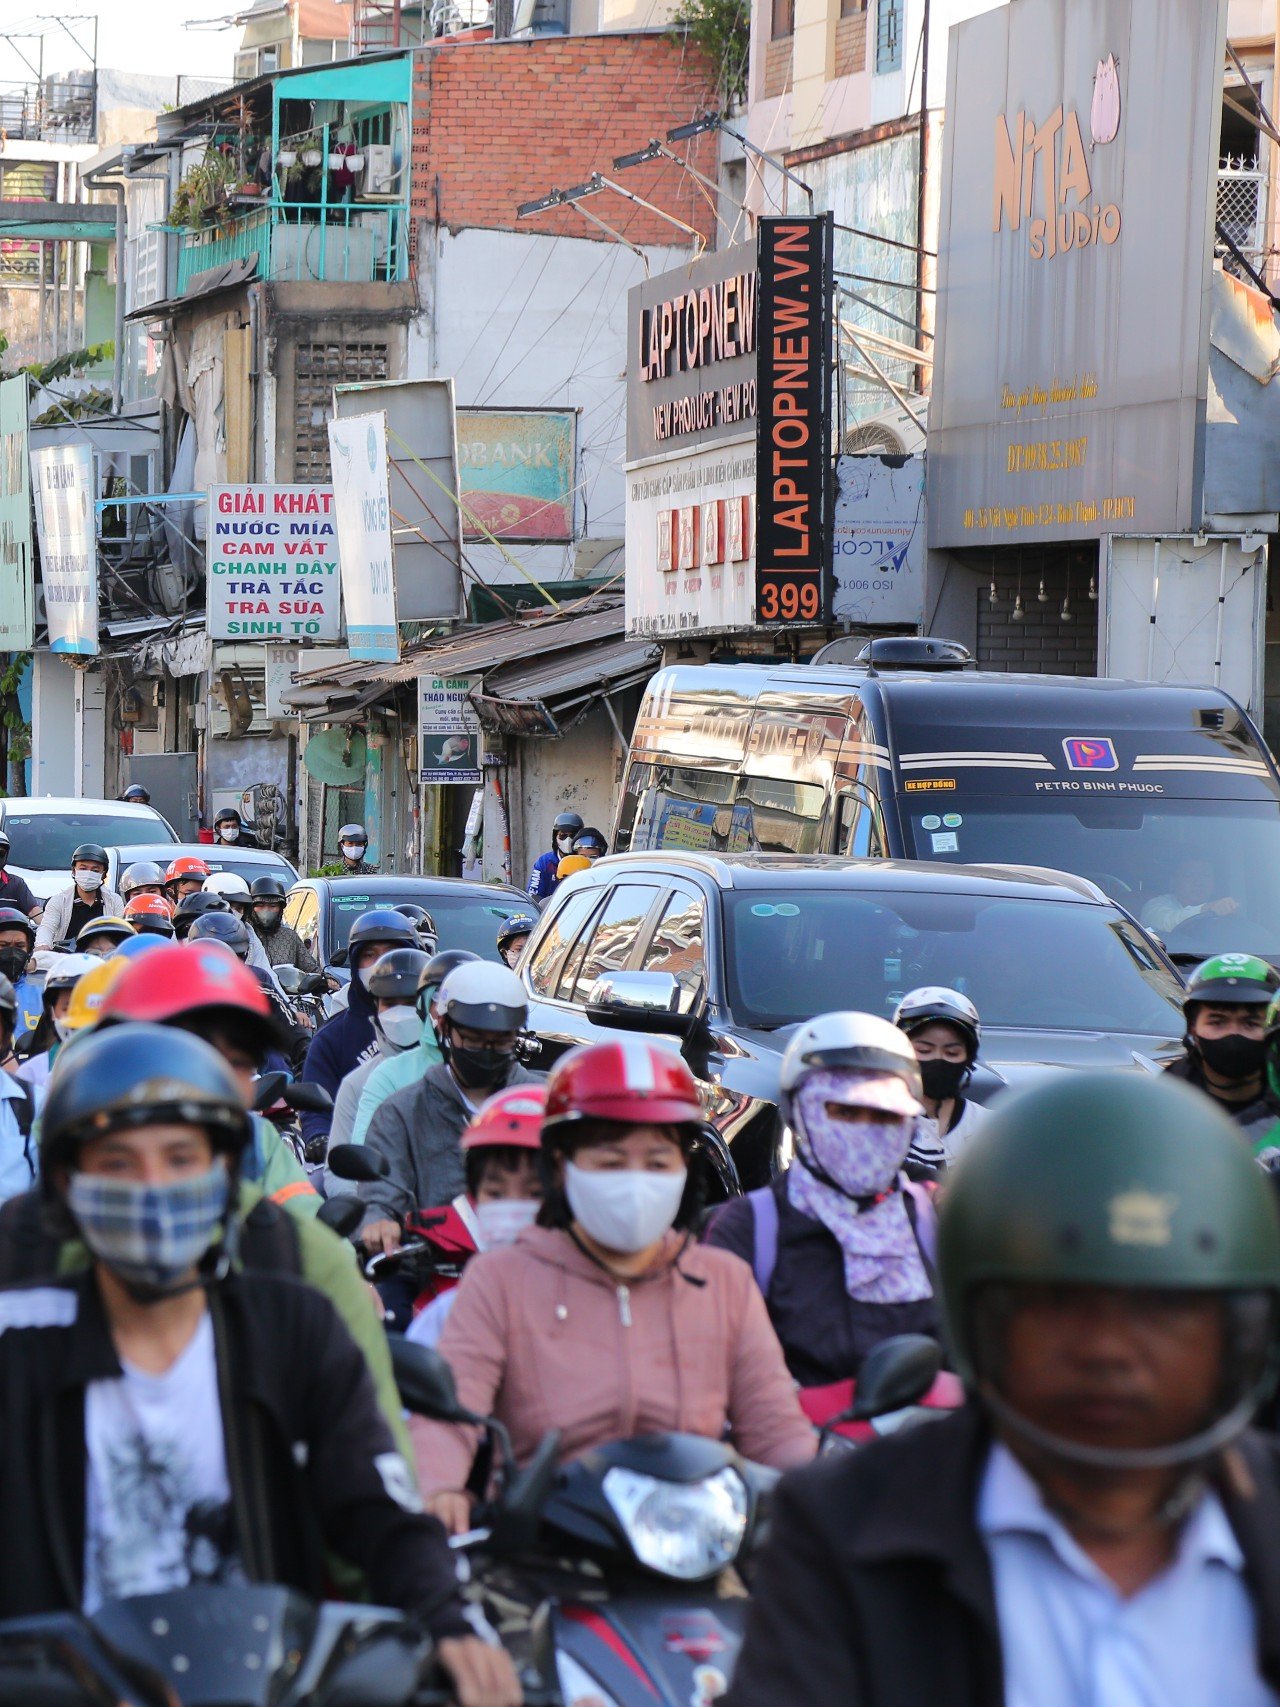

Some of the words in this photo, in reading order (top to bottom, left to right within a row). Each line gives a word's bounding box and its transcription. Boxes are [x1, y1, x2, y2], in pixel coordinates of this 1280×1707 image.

[639, 271, 757, 383] LAPTOPNEW
[773, 225, 809, 557] LAPTOPNEW.VN
[654, 405, 673, 441] NEW
[673, 391, 715, 437] PRODUCT
[720, 384, 742, 424] NEW
[218, 487, 270, 514] GIẢI
[274, 488, 334, 514] KHÁT
[216, 520, 280, 536] NƯỚC
[290, 520, 334, 536] MÍA
[222, 542, 278, 556] CAM
[284, 539, 328, 556] VẮT
[213, 562, 288, 576] CHANH
[296, 559, 337, 576] DÂY
[227, 580, 274, 595] TRÀ
[281, 578, 324, 595] TẮC
[872, 580, 893, 590] ISO
[225, 600, 273, 615] TRÀ
[279, 599, 325, 615] SỮA
[761, 582, 818, 619] 399
[227, 622, 287, 634] SINH
[292, 616, 321, 634] TỐ
[906, 781, 916, 789] XE
[916, 781, 931, 790] HỢP
[932, 779, 954, 789] ĐỒNG
[1035, 780, 1080, 792] PETRO
[1083, 781, 1115, 792] BINH
[1118, 782, 1164, 794] PHUOC
